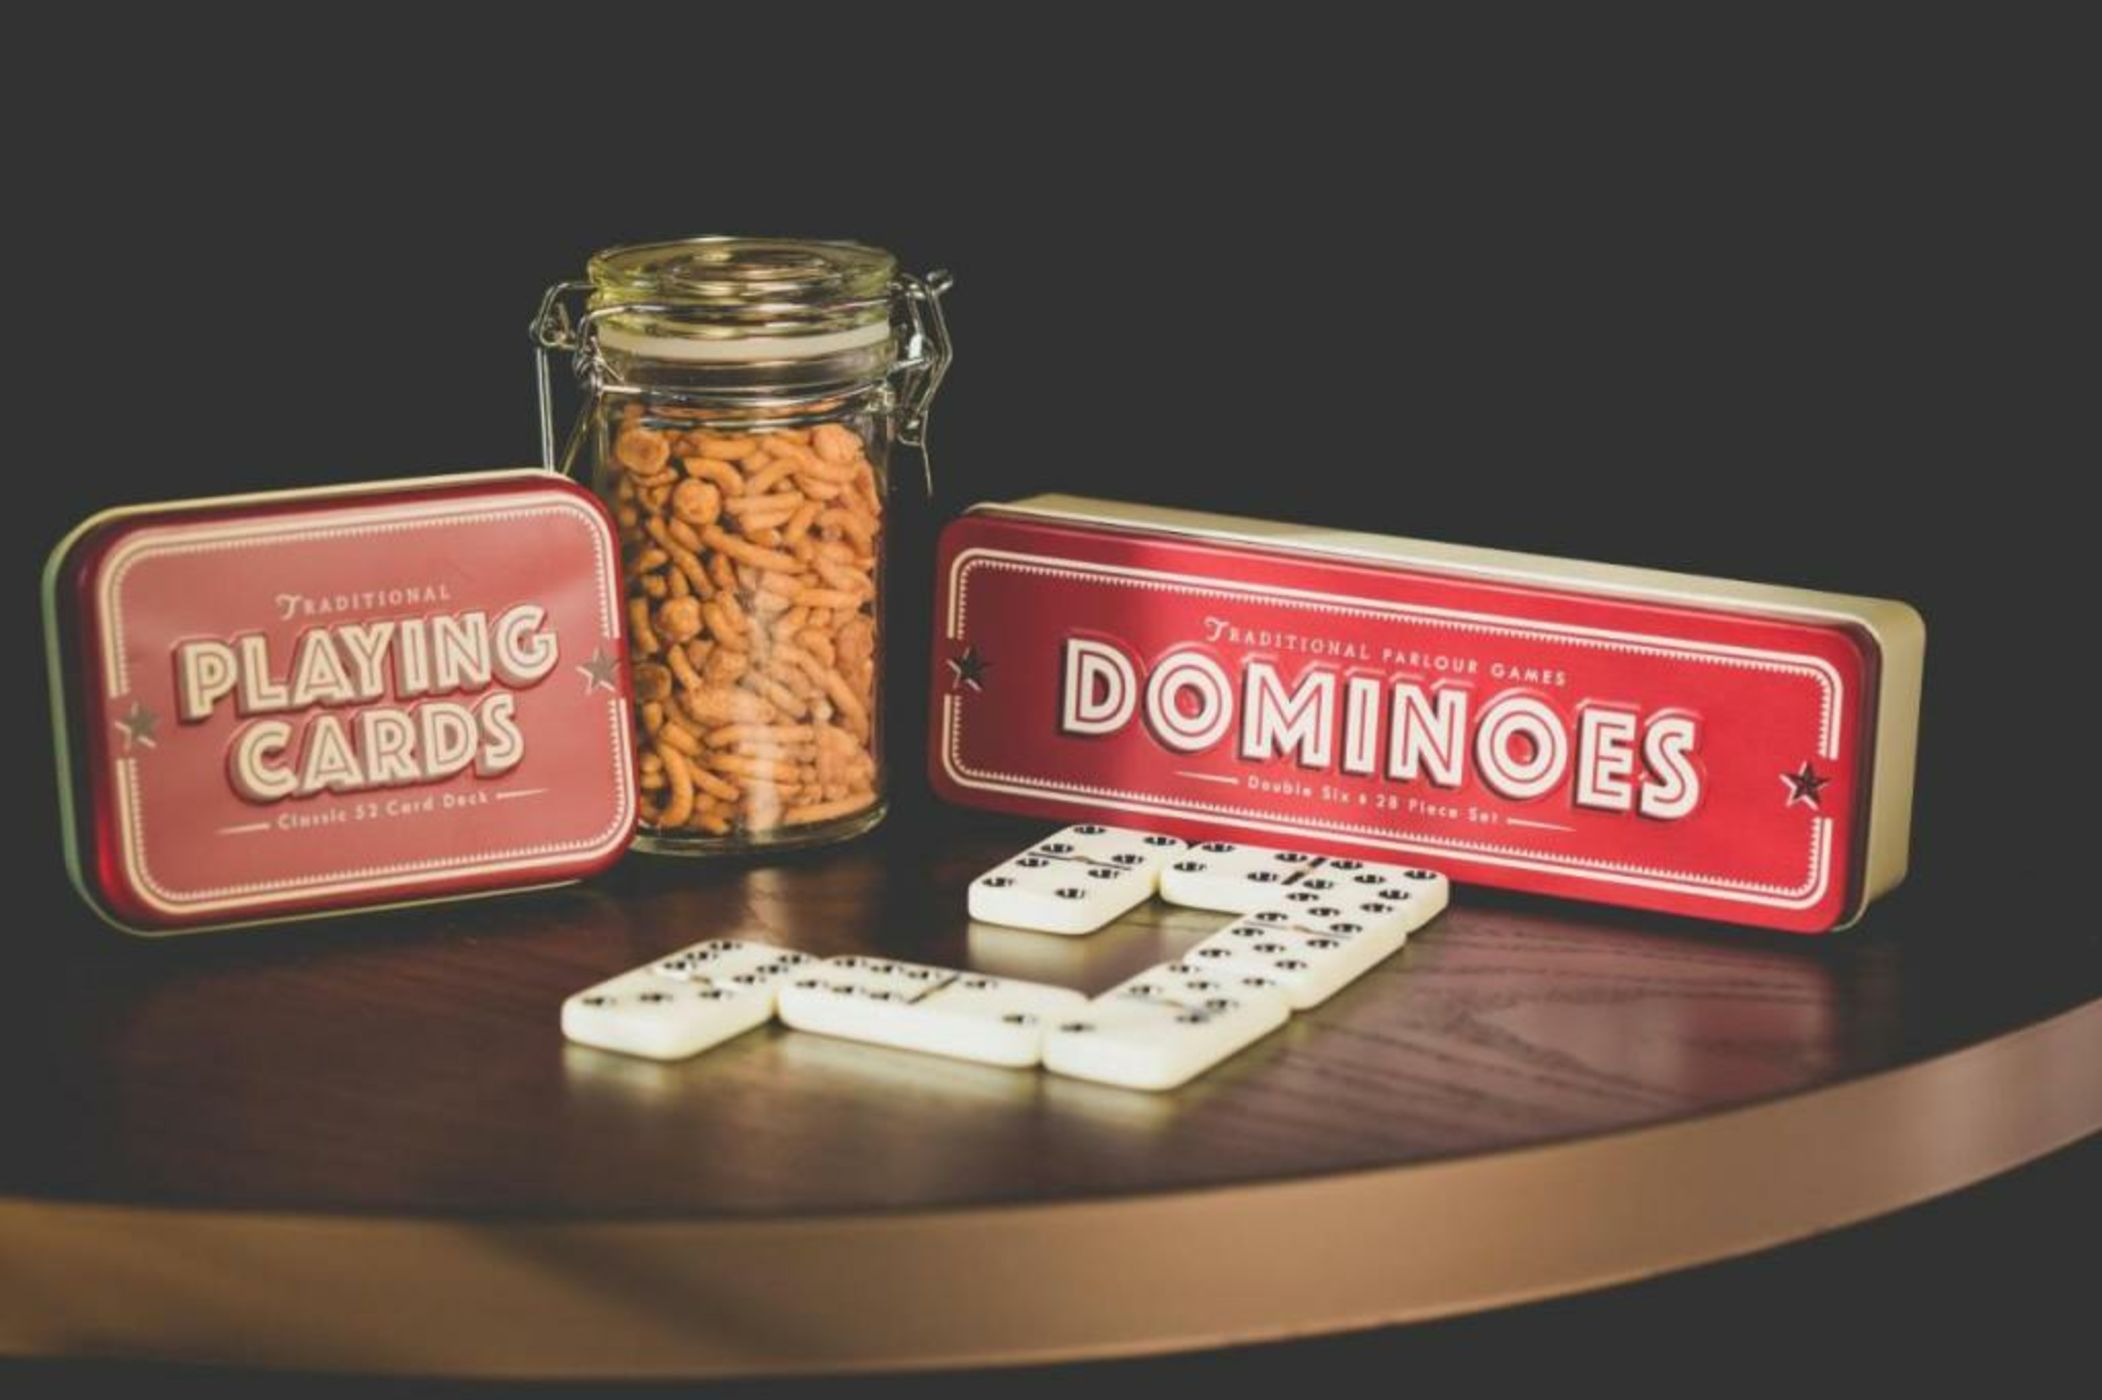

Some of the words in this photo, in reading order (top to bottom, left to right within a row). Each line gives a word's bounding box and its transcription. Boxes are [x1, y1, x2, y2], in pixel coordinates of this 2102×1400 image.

[274, 584, 450, 621] TRADITIONAL
[177, 604, 560, 722] PLAYING
[1204, 616, 1370, 660] TRADITIONAL
[1382, 648, 1479, 674] PARLOUR
[1491, 662, 1567, 687] GAMES
[233, 694, 524, 801] CARDS
[1062, 637, 1702, 820] DOMINOES
[277, 807, 347, 830] Classic
[355, 802, 379, 820] 52
[386, 797, 434, 816] Card
[442, 791, 488, 809] Deck
[1247, 774, 1312, 798] Double
[1321, 784, 1350, 805] Six
[1376, 793, 1399, 810] 28
[1408, 797, 1459, 819] Piece
[1468, 806, 1499, 824] Set
